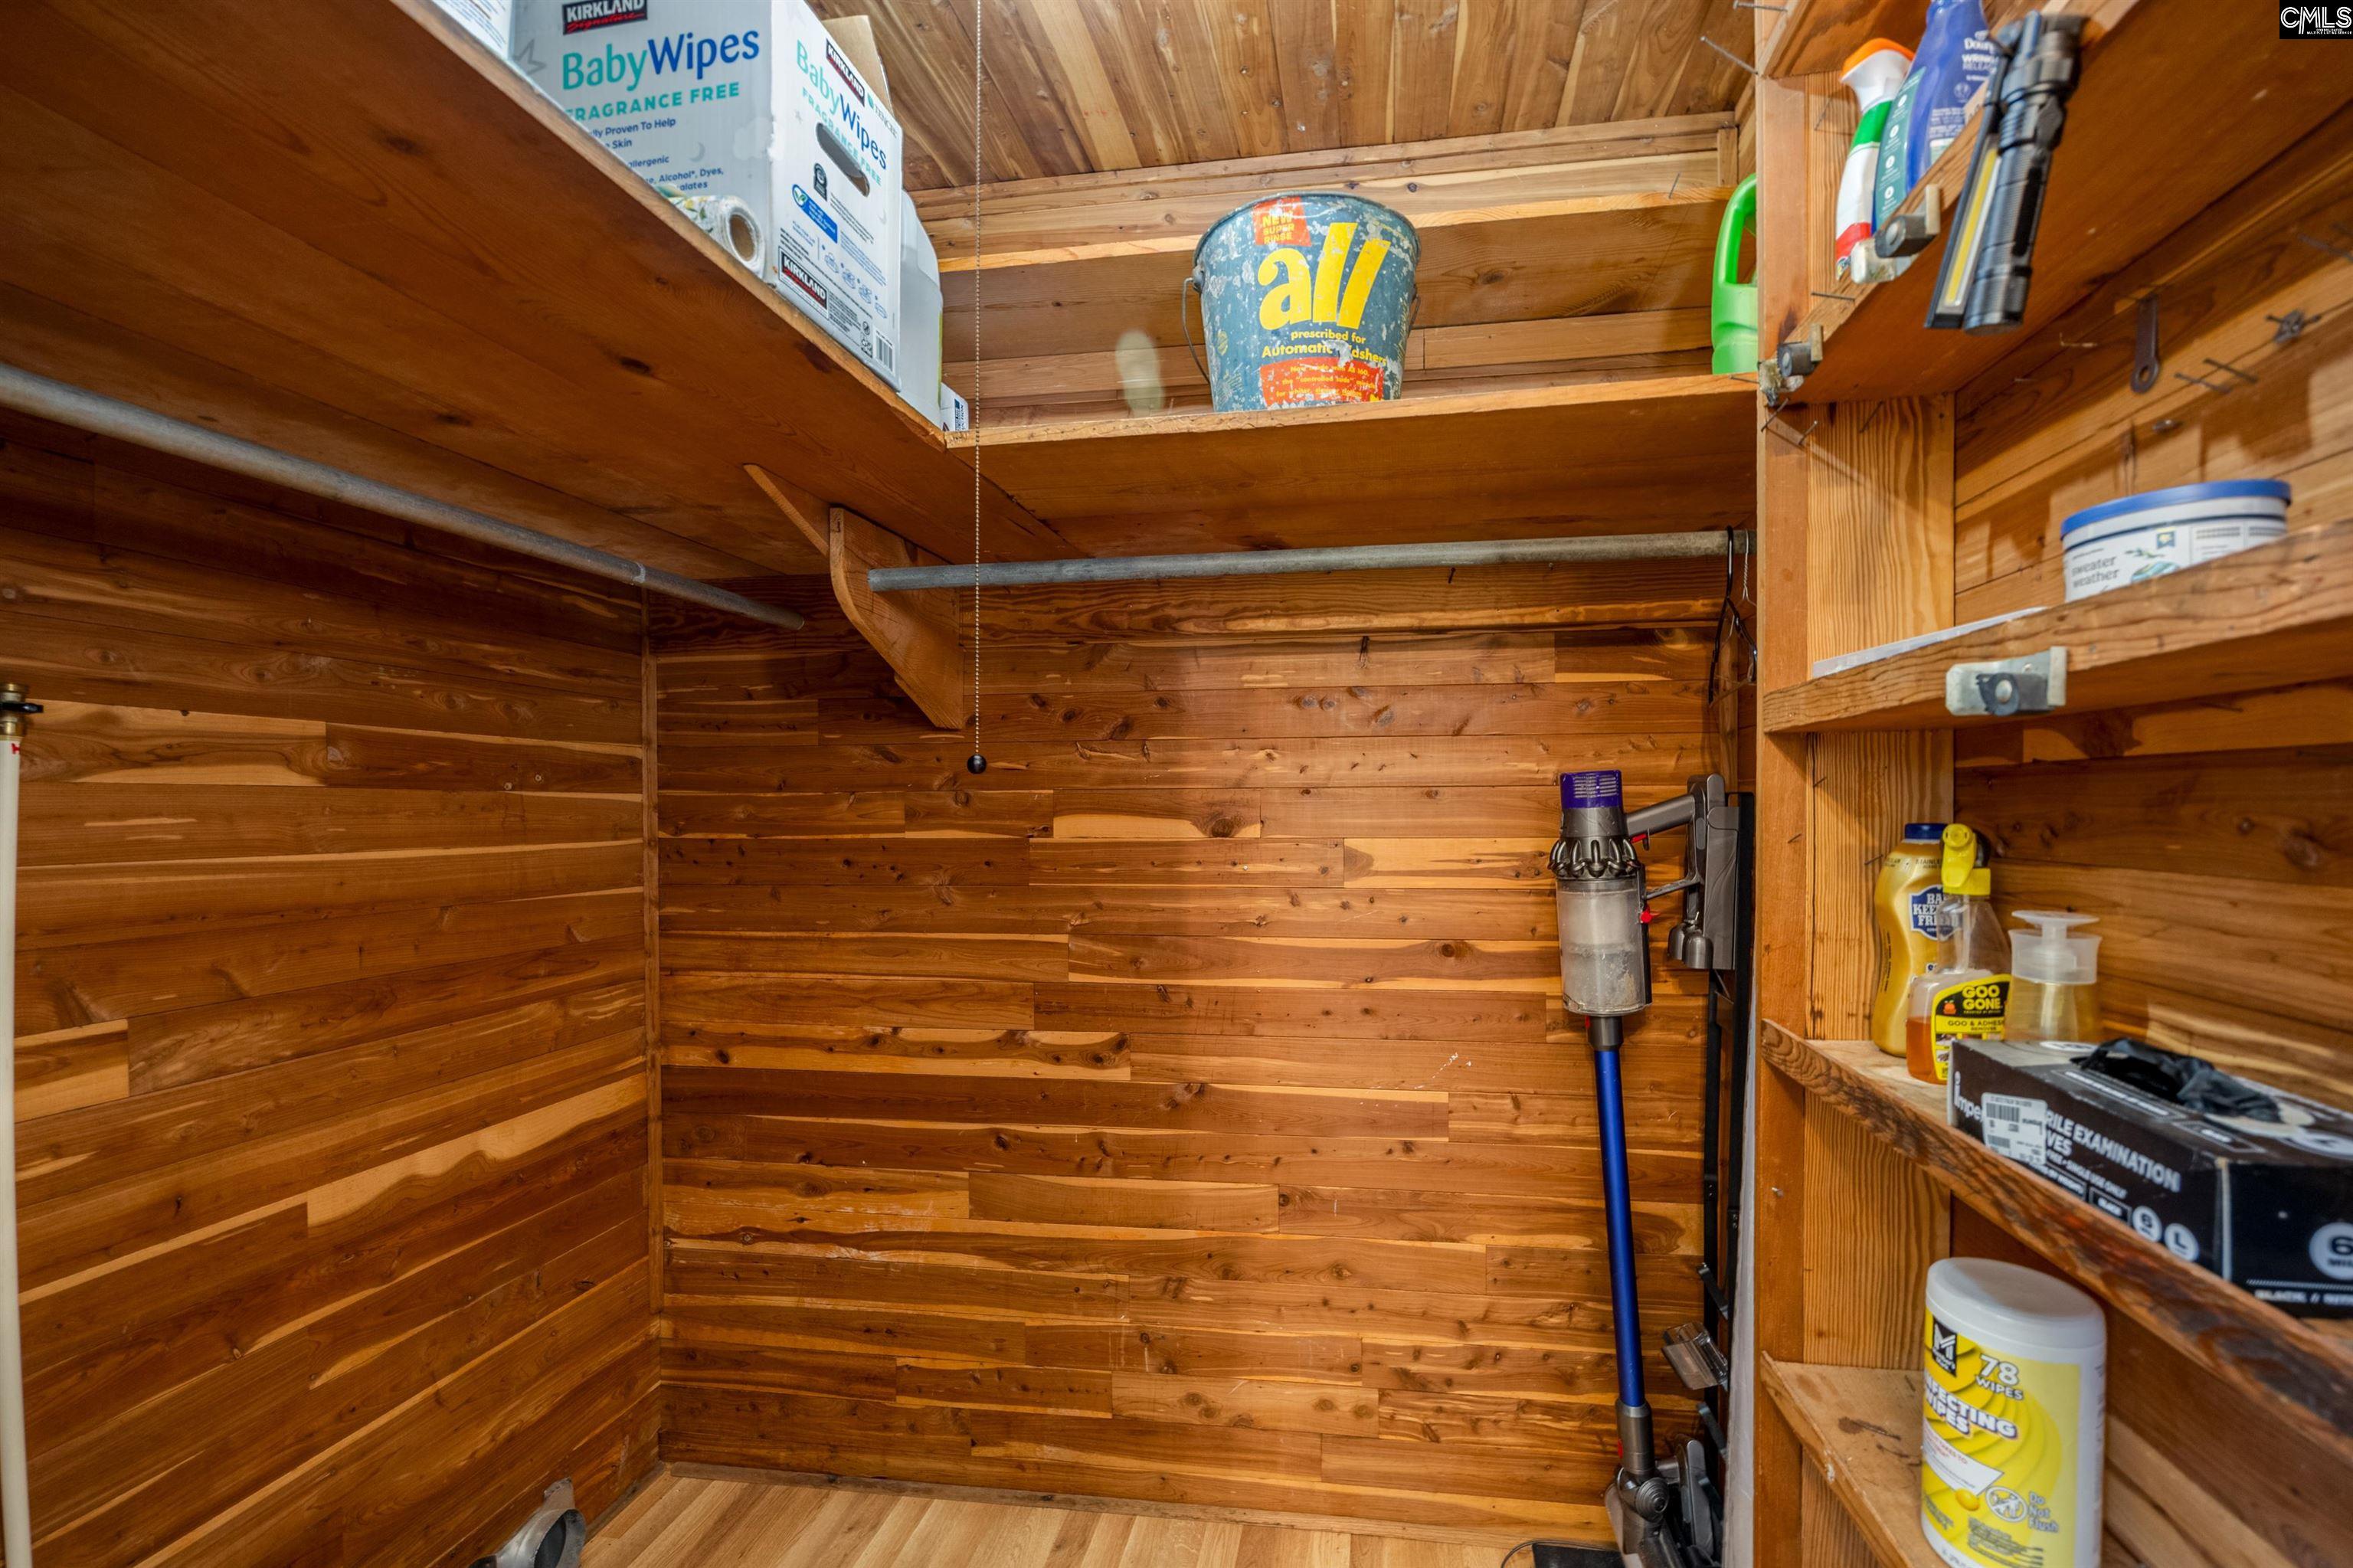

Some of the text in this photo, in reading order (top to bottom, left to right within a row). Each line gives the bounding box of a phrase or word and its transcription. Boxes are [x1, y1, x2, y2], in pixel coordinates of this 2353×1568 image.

[567, 0, 645, 22] KIRKLAND
[690, 82, 740, 103] FREE
[605, 123, 639, 136] Proven
[641, 120, 652, 130] To
[655, 117, 676, 129] Help
[612, 139, 633, 149] Skin
[628, 155, 669, 168] allergenic
[700, 167, 724, 177] Dyes,
[861, 157, 882, 186] FREE
[1262, 210, 1292, 228] NEW
[783, 255, 826, 301] KIRKLAND
[1258, 222, 1392, 330] all
[1291, 329, 1366, 344] prescribed for
[1350, 345, 1387, 365] ashers
[1926, 893, 1944, 905] BA
[1962, 985, 2001, 999] GOO
[2046, 1129, 2073, 1157] VES
[2046, 1108, 2181, 1193] RILE EXAMINATION
[2175, 1232, 2188, 1249] L
[2332, 1236, 2353, 1256] 6
[1979, 1353, 2020, 1386] 78
[1975, 1376, 2024, 1401] WIPES
[2029, 1491, 2045, 1505] Do
[2029, 1504, 2050, 1519] Not
[2028, 1517, 2059, 1534] Flush
